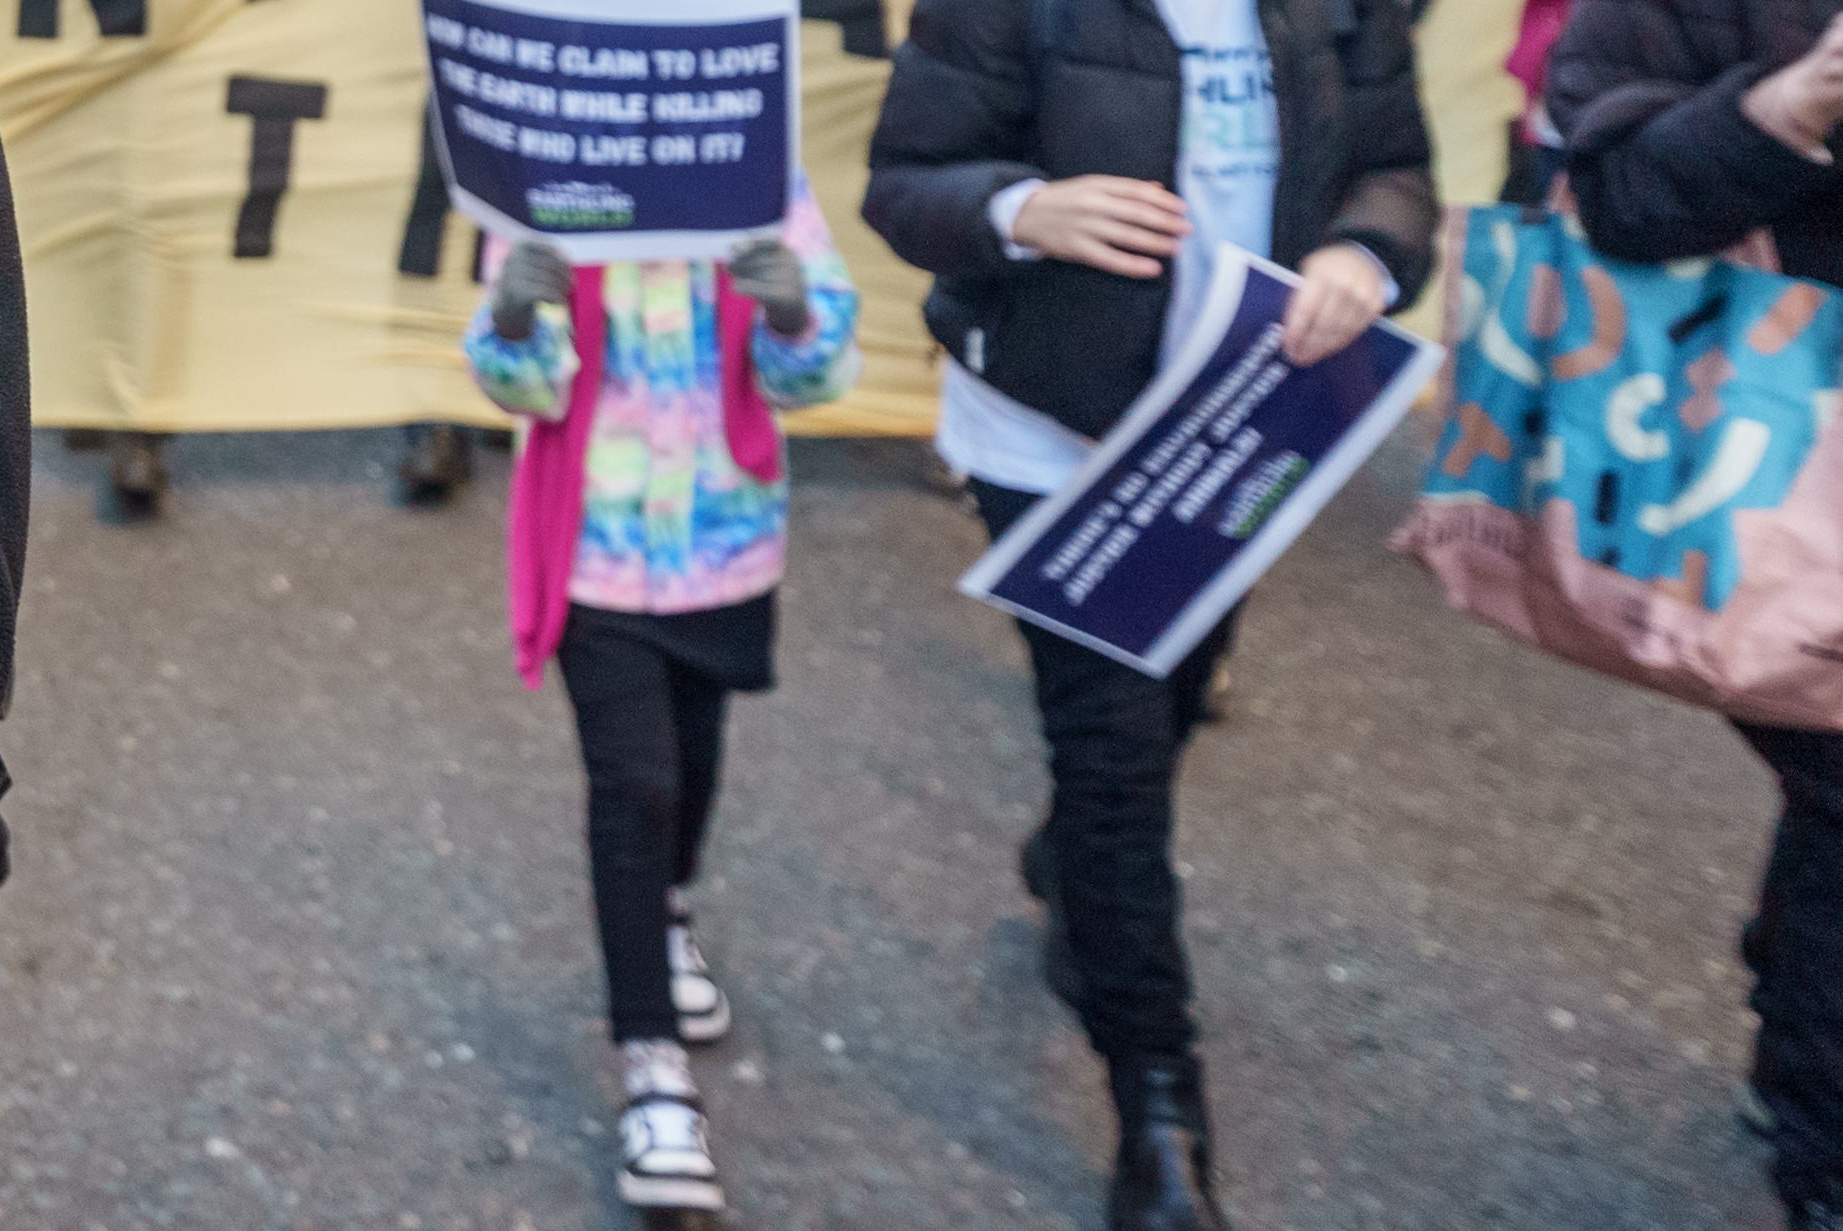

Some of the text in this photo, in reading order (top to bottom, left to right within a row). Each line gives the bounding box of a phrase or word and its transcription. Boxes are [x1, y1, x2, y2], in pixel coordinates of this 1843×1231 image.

[468, 27, 512, 66] CAN
[558, 44, 649, 80] CLAIM
[654, 48, 696, 80] TO
[701, 42, 780, 79] LOVE
[480, 70, 556, 116] EARTH
[559, 88, 648, 123] WHILE
[652, 88, 763, 122] KILLING
[518, 125, 577, 165] WHO
[579, 132, 648, 167] LIVE
[650, 133, 696, 166] ON
